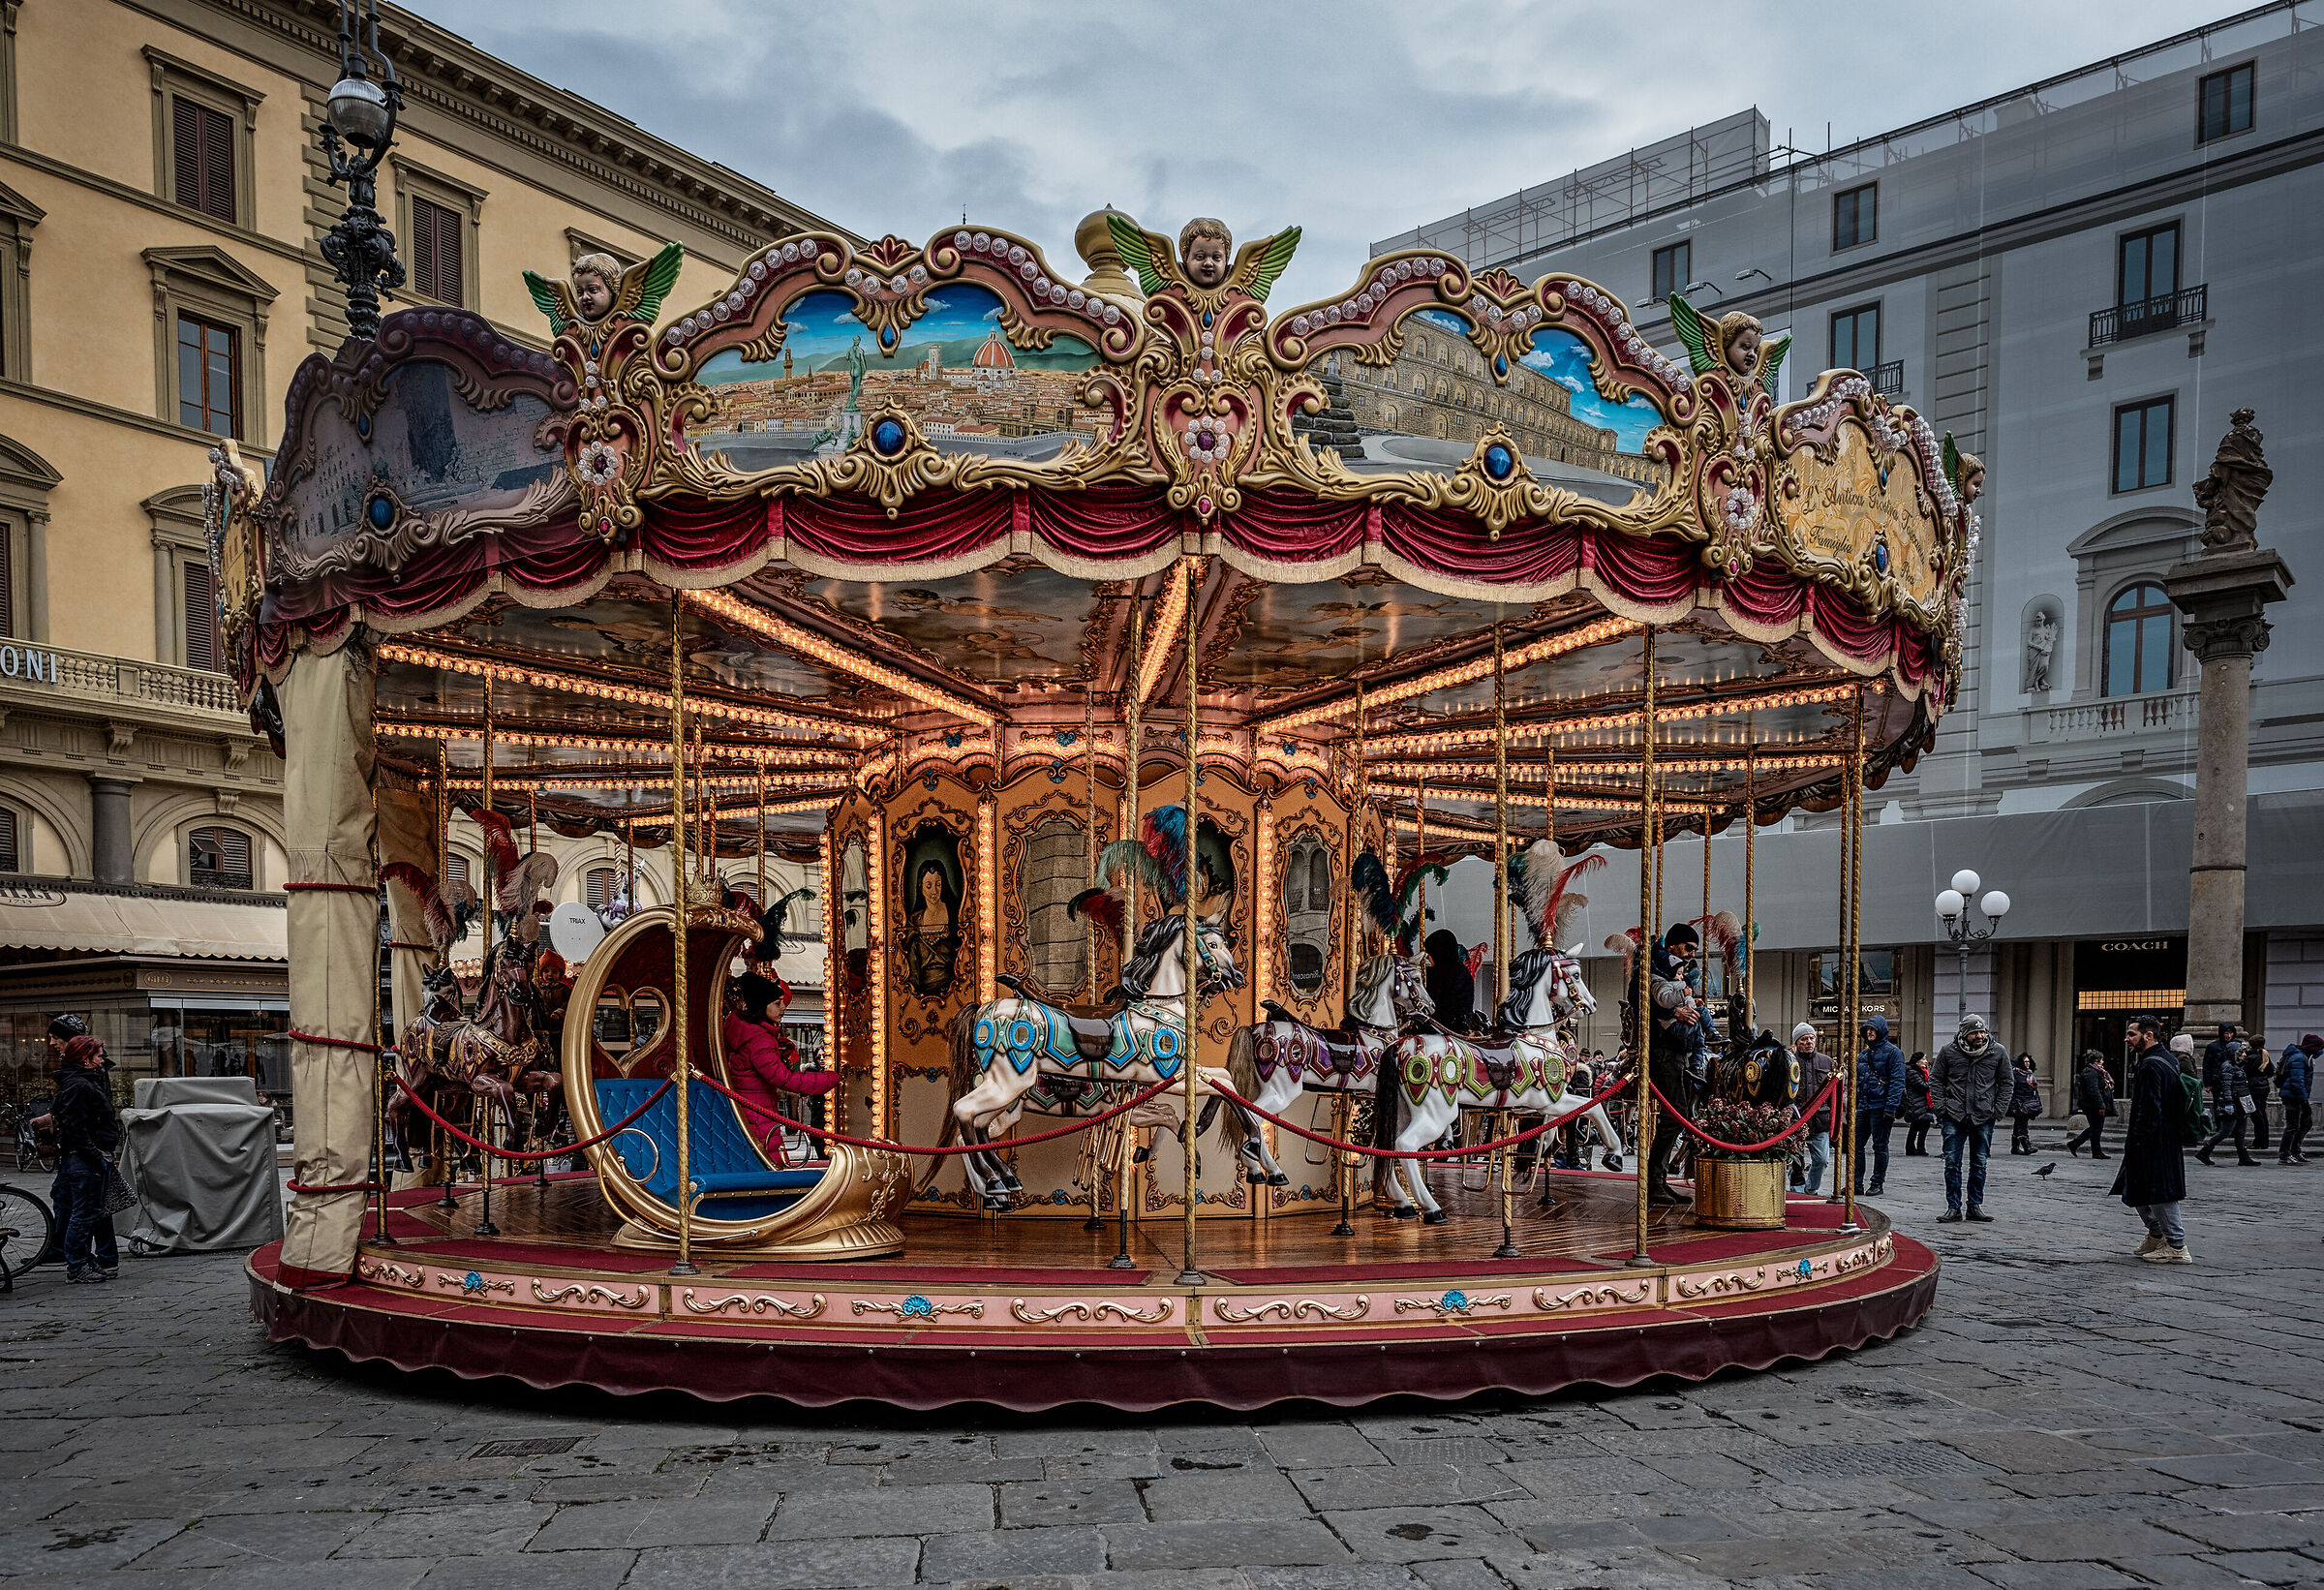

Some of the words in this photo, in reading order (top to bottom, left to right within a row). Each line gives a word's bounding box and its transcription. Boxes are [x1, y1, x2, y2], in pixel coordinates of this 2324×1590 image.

[1809, 525, 1852, 558] Famiglia
[0, 645, 57, 683] ONI
[2101, 941, 2168, 951] COACH
[1861, 1004, 1885, 1013] KORS
